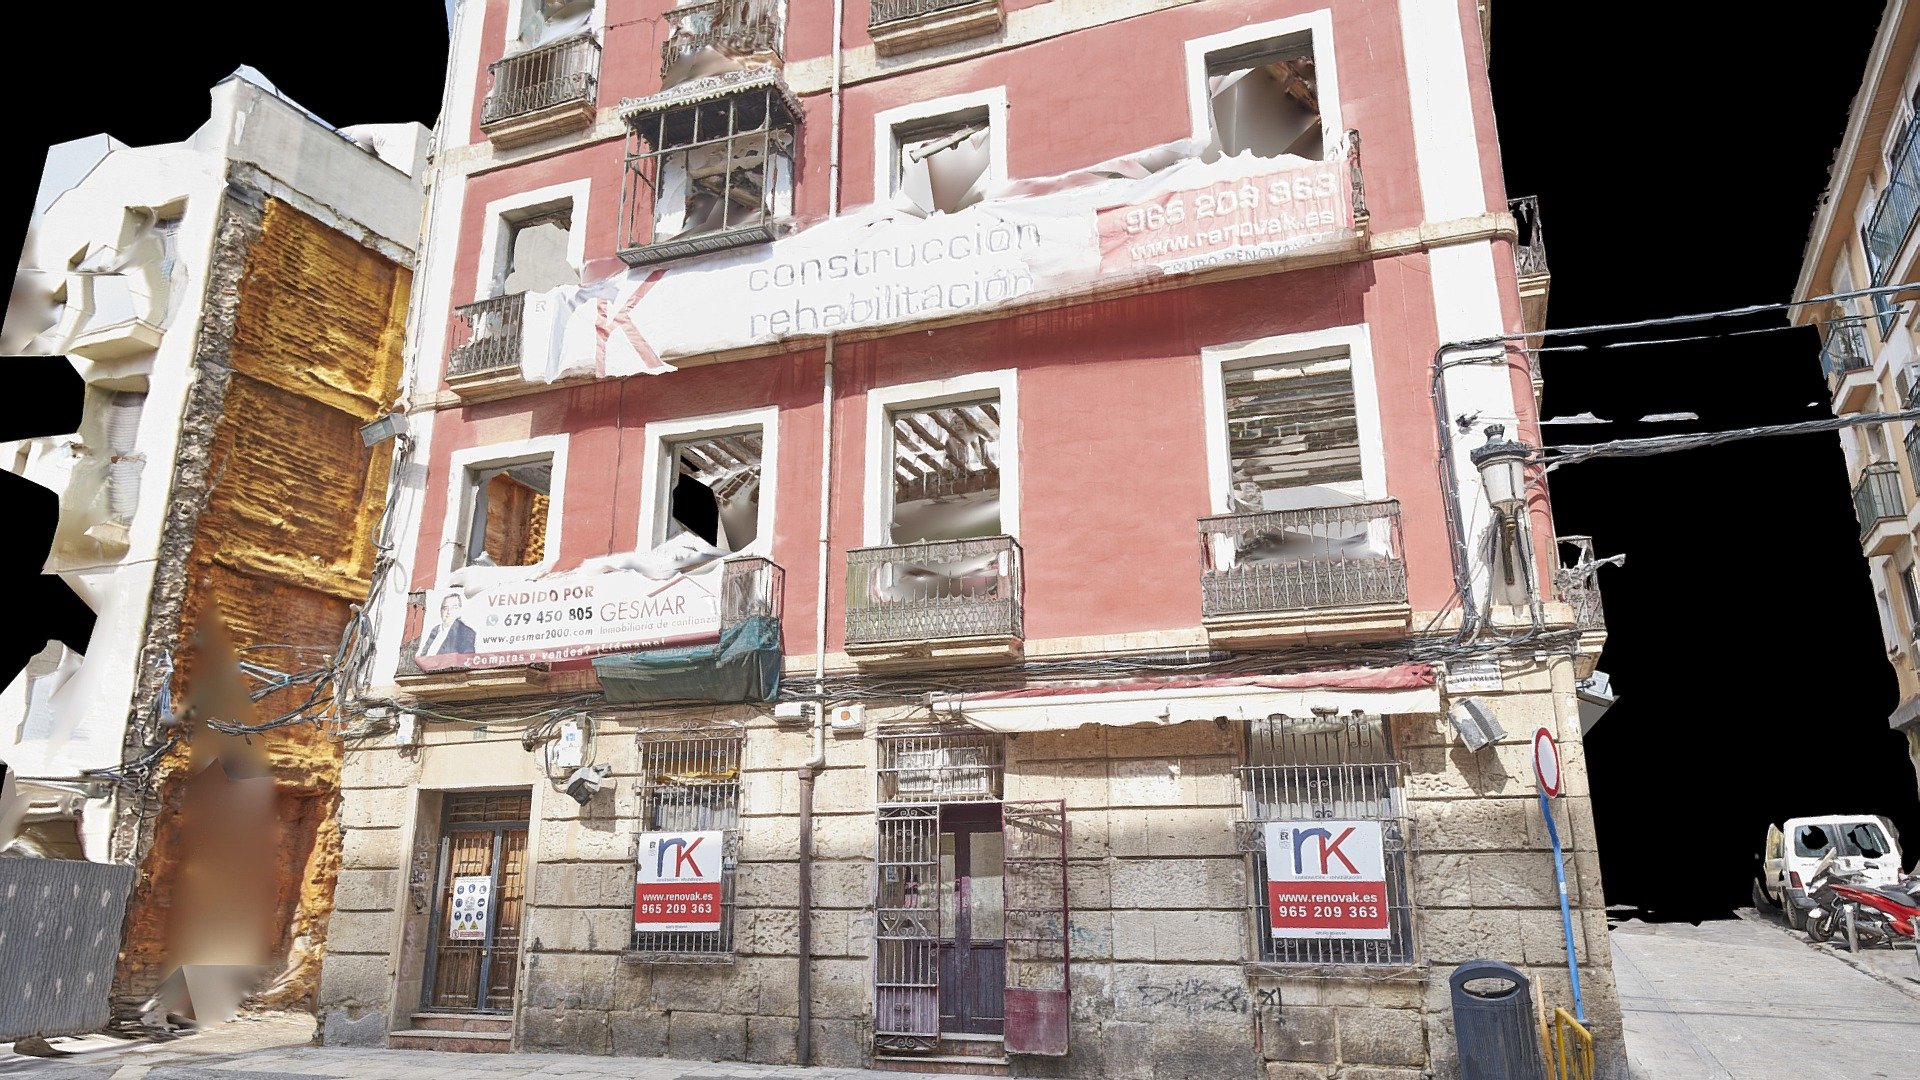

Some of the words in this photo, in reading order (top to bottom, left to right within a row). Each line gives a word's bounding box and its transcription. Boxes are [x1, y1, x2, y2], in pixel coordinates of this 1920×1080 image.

[1195, 184, 1260, 218] 209
[748, 219, 1041, 292] construcción
[749, 268, 1035, 339] rehabilitación
[488, 589, 559, 608] VENDIDO
[563, 585, 595, 601] POR
[504, 612, 531, 627] 679
[536, 610, 563, 625] 450
[568, 606, 593, 621] 805
[600, 595, 686, 622] GESMAR
[658, 617, 669, 629] de
[482, 628, 594, 645] www.gesmar2000.com
[464, 653, 524, 667] ¿Compras
[529, 653, 537, 661] o
[541, 643, 591, 660] vendes?
[642, 891, 714, 901] www.renovak.es
[1278, 892, 1378, 903] www.renovak.es
[641, 904, 662, 914] 965
[666, 904, 687, 914] 209
[691, 903, 712, 914] 363
[1279, 906, 1308, 918] 965
[1313, 906, 1342, 918] 209
[1349, 906, 1378, 918] 363
